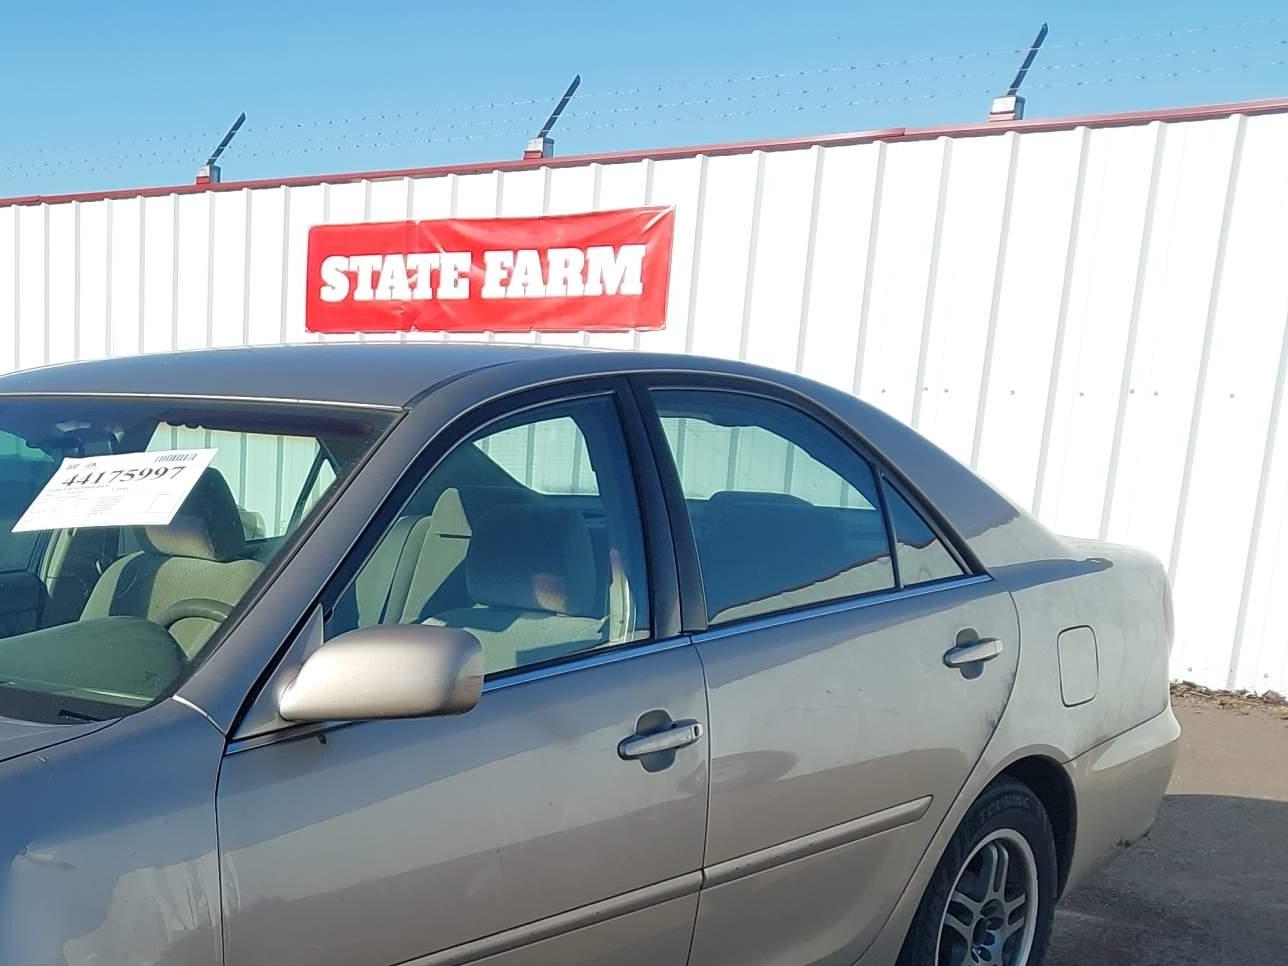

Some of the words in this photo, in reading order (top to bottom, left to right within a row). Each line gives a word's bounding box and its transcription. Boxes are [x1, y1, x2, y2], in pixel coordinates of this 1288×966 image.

[320, 251, 472, 302] STATE
[480, 244, 646, 300] FARM
[62, 466, 186, 487] 44175997
